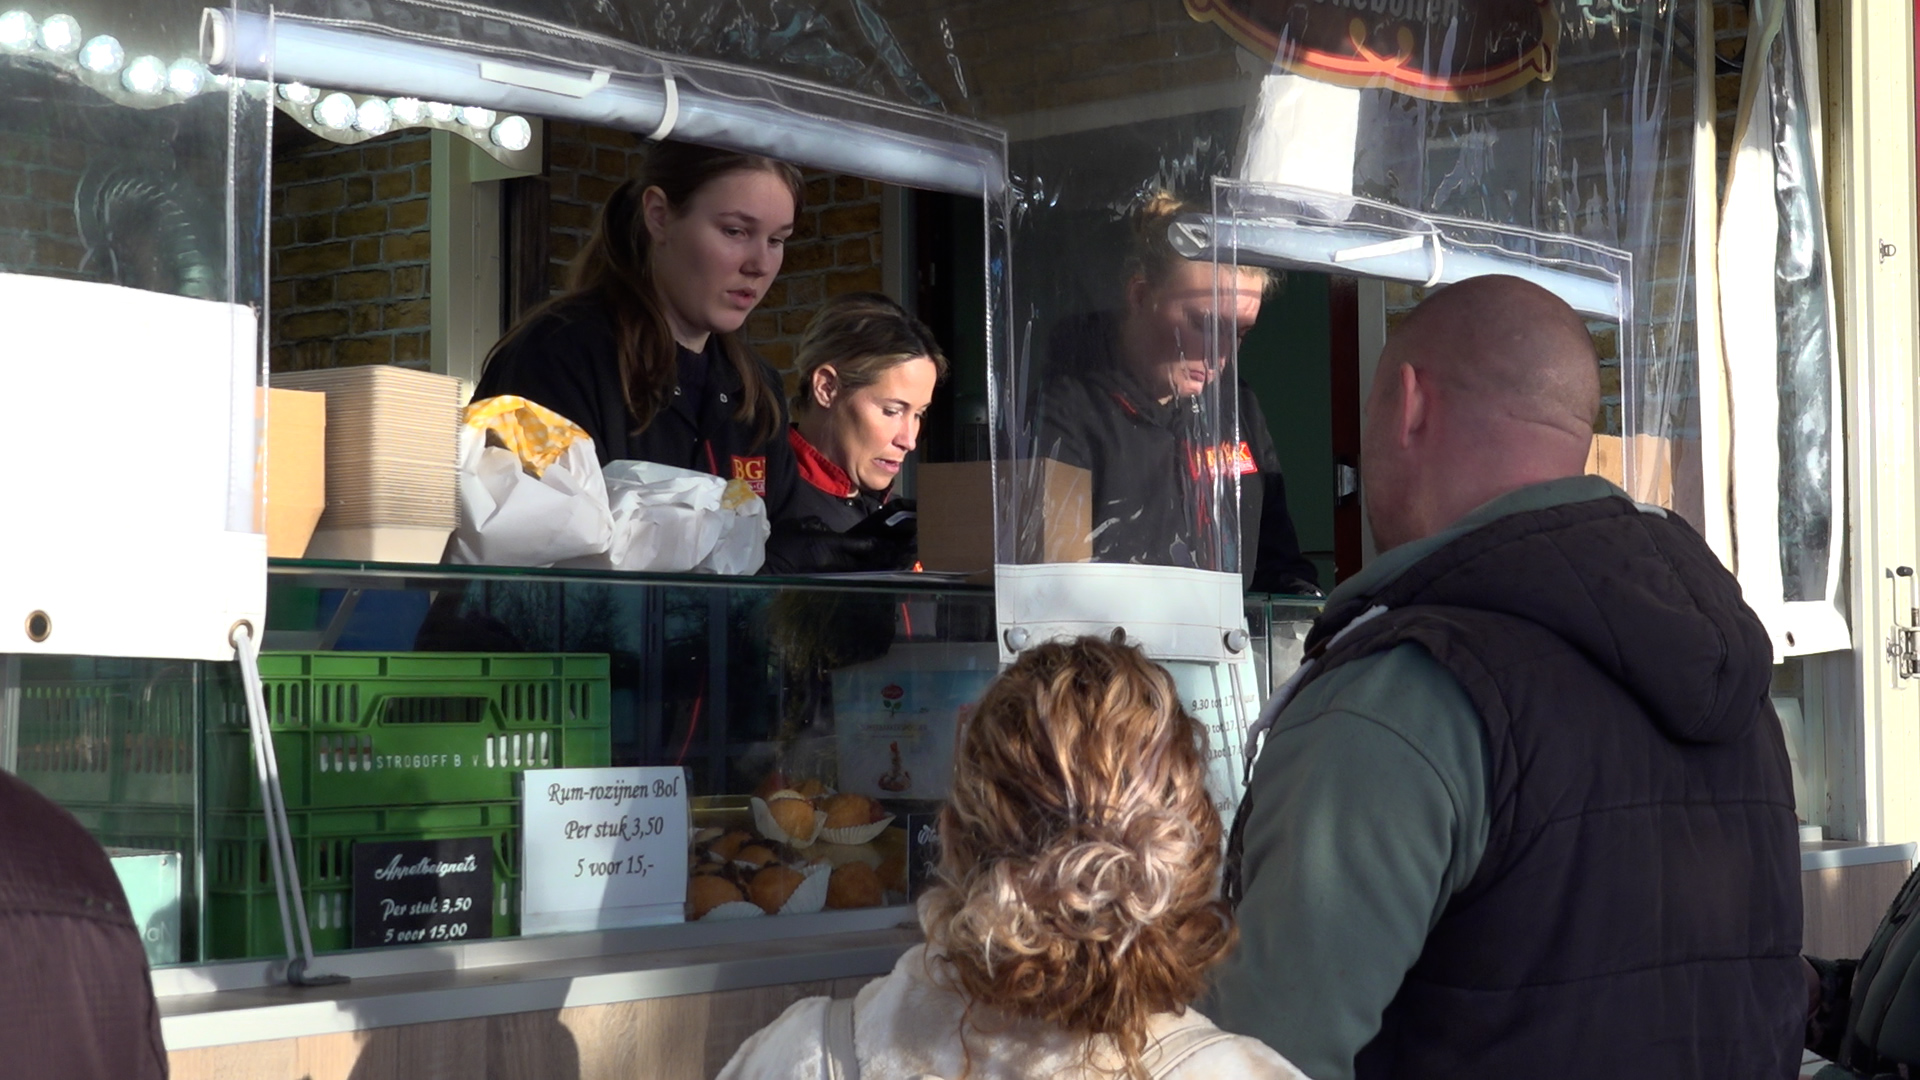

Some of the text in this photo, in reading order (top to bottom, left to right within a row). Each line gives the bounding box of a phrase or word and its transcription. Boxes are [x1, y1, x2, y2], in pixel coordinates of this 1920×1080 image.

[1191, 699, 1210, 711] 9.30
[548, 776, 679, 806] Rum-rozijnen Bol
[564, 815, 664, 841] Per stuk 3,50
[374, 853, 477, 881] Appelbeignets
[574, 854, 654, 877] 5 voor 15,-
[380, 896, 472, 921] Per stuk 3,50
[384, 922, 468, 942] 5 voor 15,00
